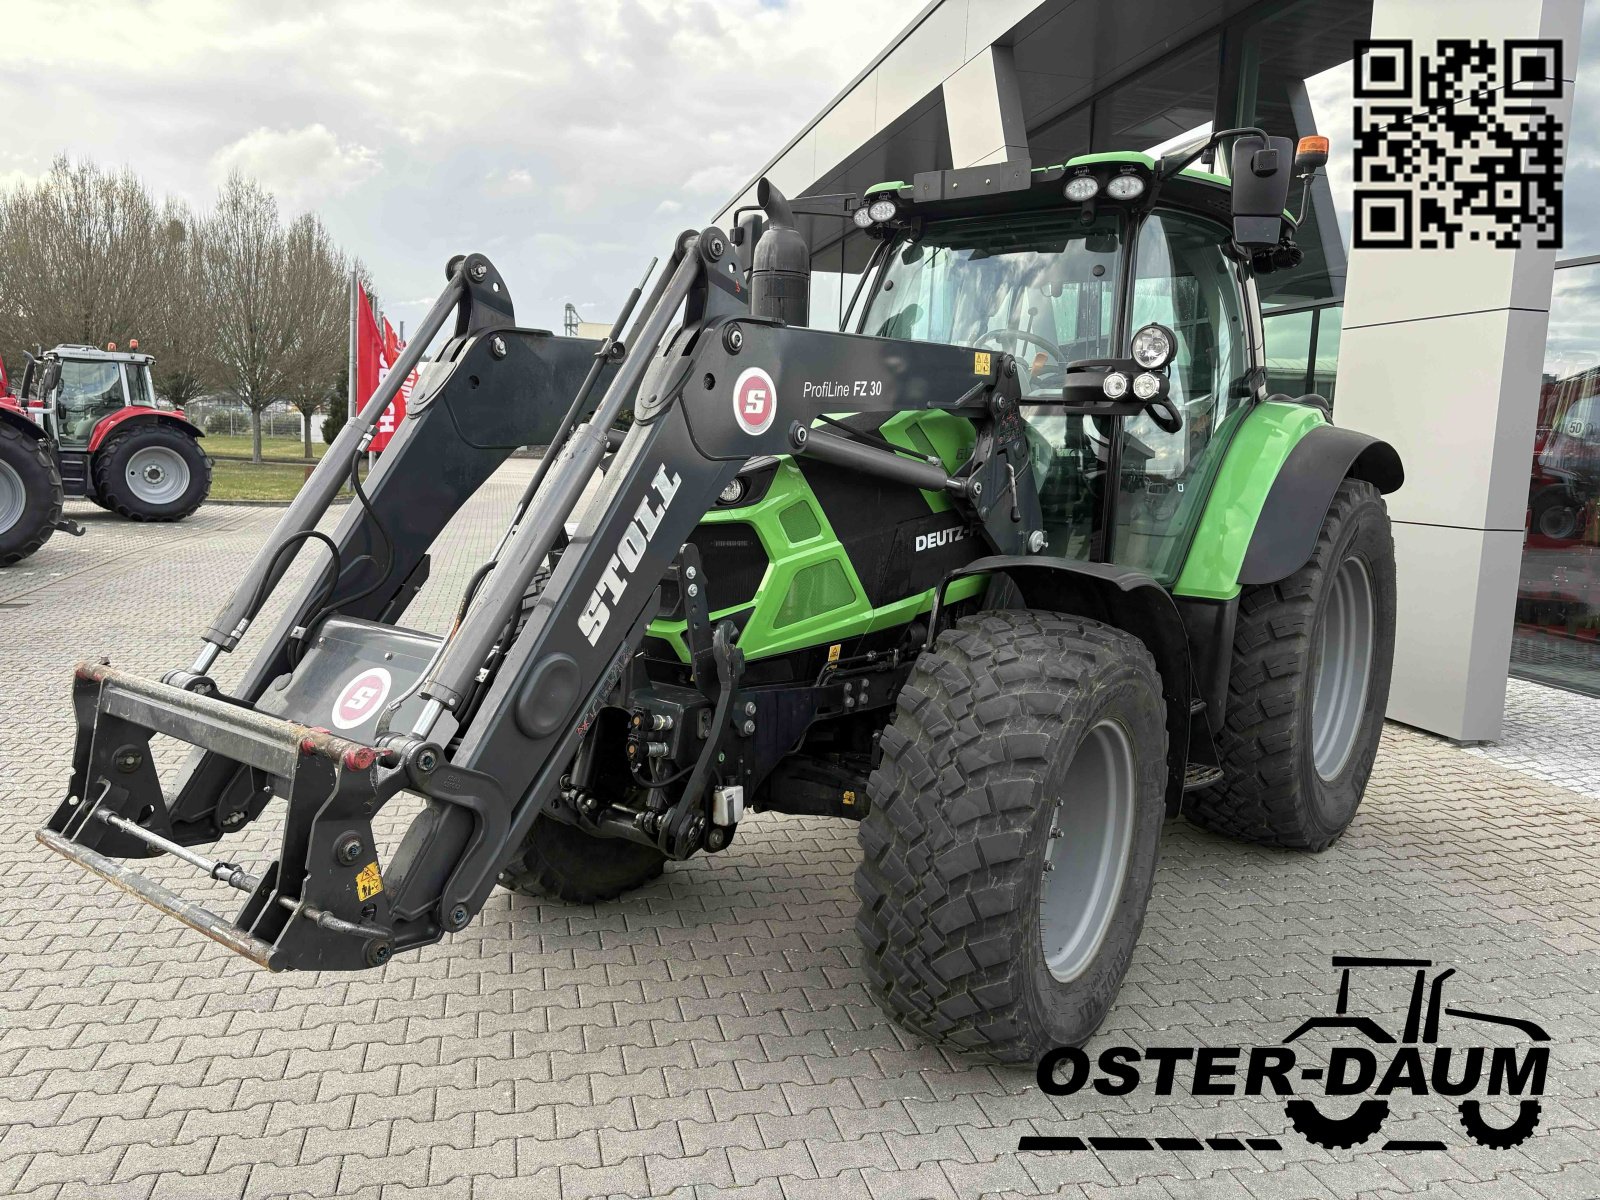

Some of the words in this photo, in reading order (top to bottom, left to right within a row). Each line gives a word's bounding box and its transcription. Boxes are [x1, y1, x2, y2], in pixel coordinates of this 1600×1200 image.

[803, 381, 850, 398] ProfiLine
[853, 380, 868, 396] FZ
[869, 380, 882, 396] 30
[744, 389, 767, 414] S
[1569, 421, 1583, 434] 50
[577, 462, 682, 647] STOLL
[343, 686, 378, 710] S
